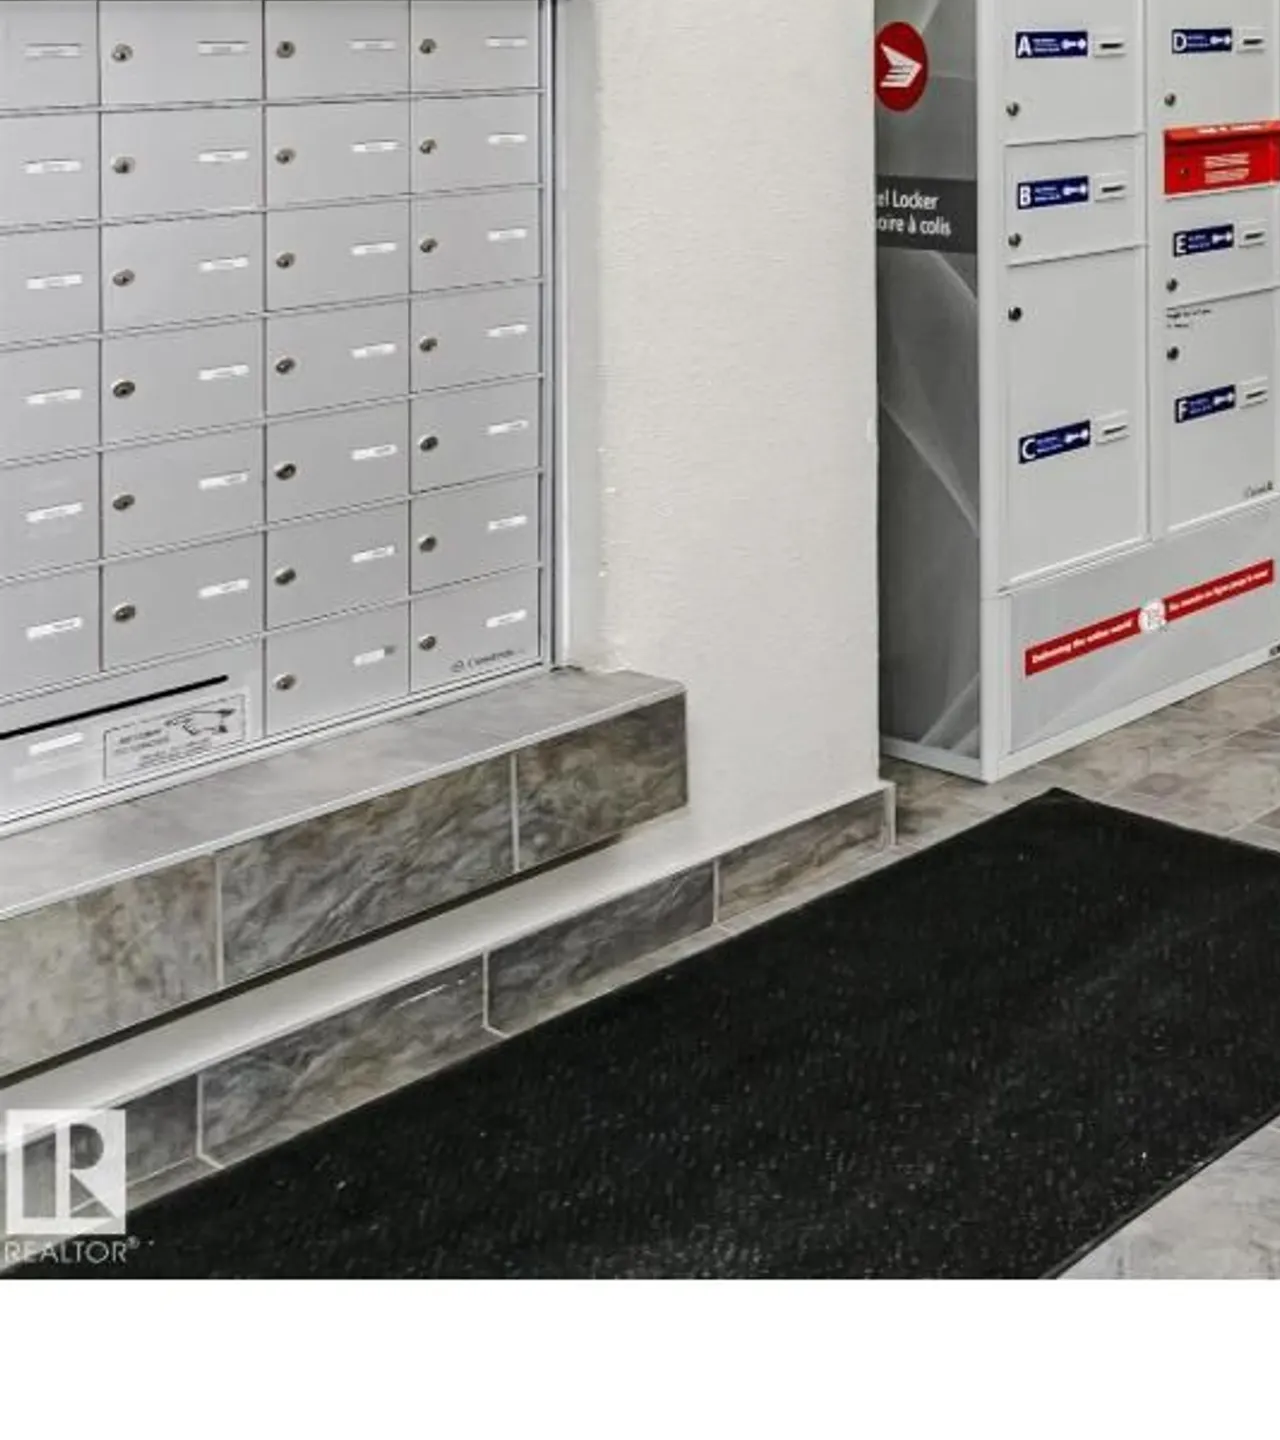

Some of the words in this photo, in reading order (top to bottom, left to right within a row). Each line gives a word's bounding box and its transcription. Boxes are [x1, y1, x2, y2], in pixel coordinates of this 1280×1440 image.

[1018, 35, 1032, 56] A
[1173, 32, 1187, 51] D
[892, 188, 939, 210] Locker
[1020, 186, 1032, 207] B
[1176, 234, 1188, 254] E
[1179, 400, 1188, 420] F
[1022, 438, 1037, 460] C
